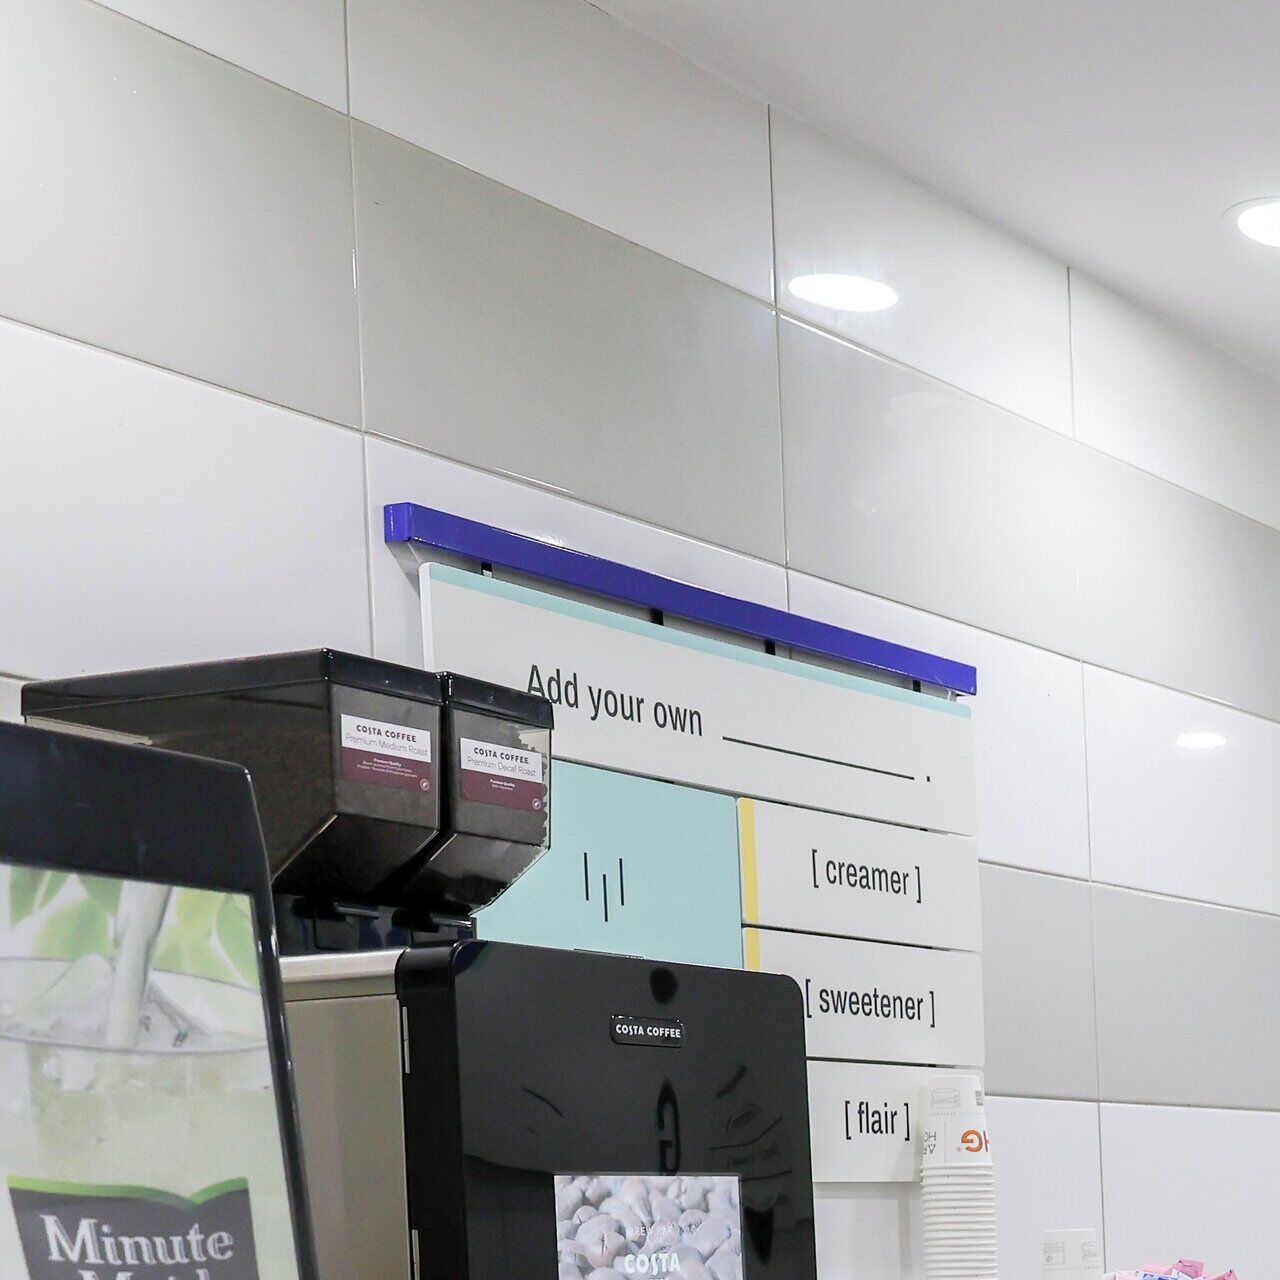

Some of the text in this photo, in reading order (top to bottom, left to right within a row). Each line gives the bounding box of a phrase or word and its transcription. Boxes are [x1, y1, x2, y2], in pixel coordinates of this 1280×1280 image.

[527, 664, 703, 737] Add your own
[345, 733, 378, 746] Premium
[356, 724, 417, 743] COSTA COFFEE
[467, 756, 497, 769] Premium
[497, 761, 517, 773] Decaf
[473, 747, 529, 764] COSTA COFFEE
[825, 859, 909, 896] creamer
[819, 987, 924, 1021] sweetener
[616, 1023, 681, 1038] COSTA COFFEE
[857, 1101, 898, 1134] flair
[40, 1214, 234, 1266] Minute
[623, 1252, 681, 1276] COSTA
